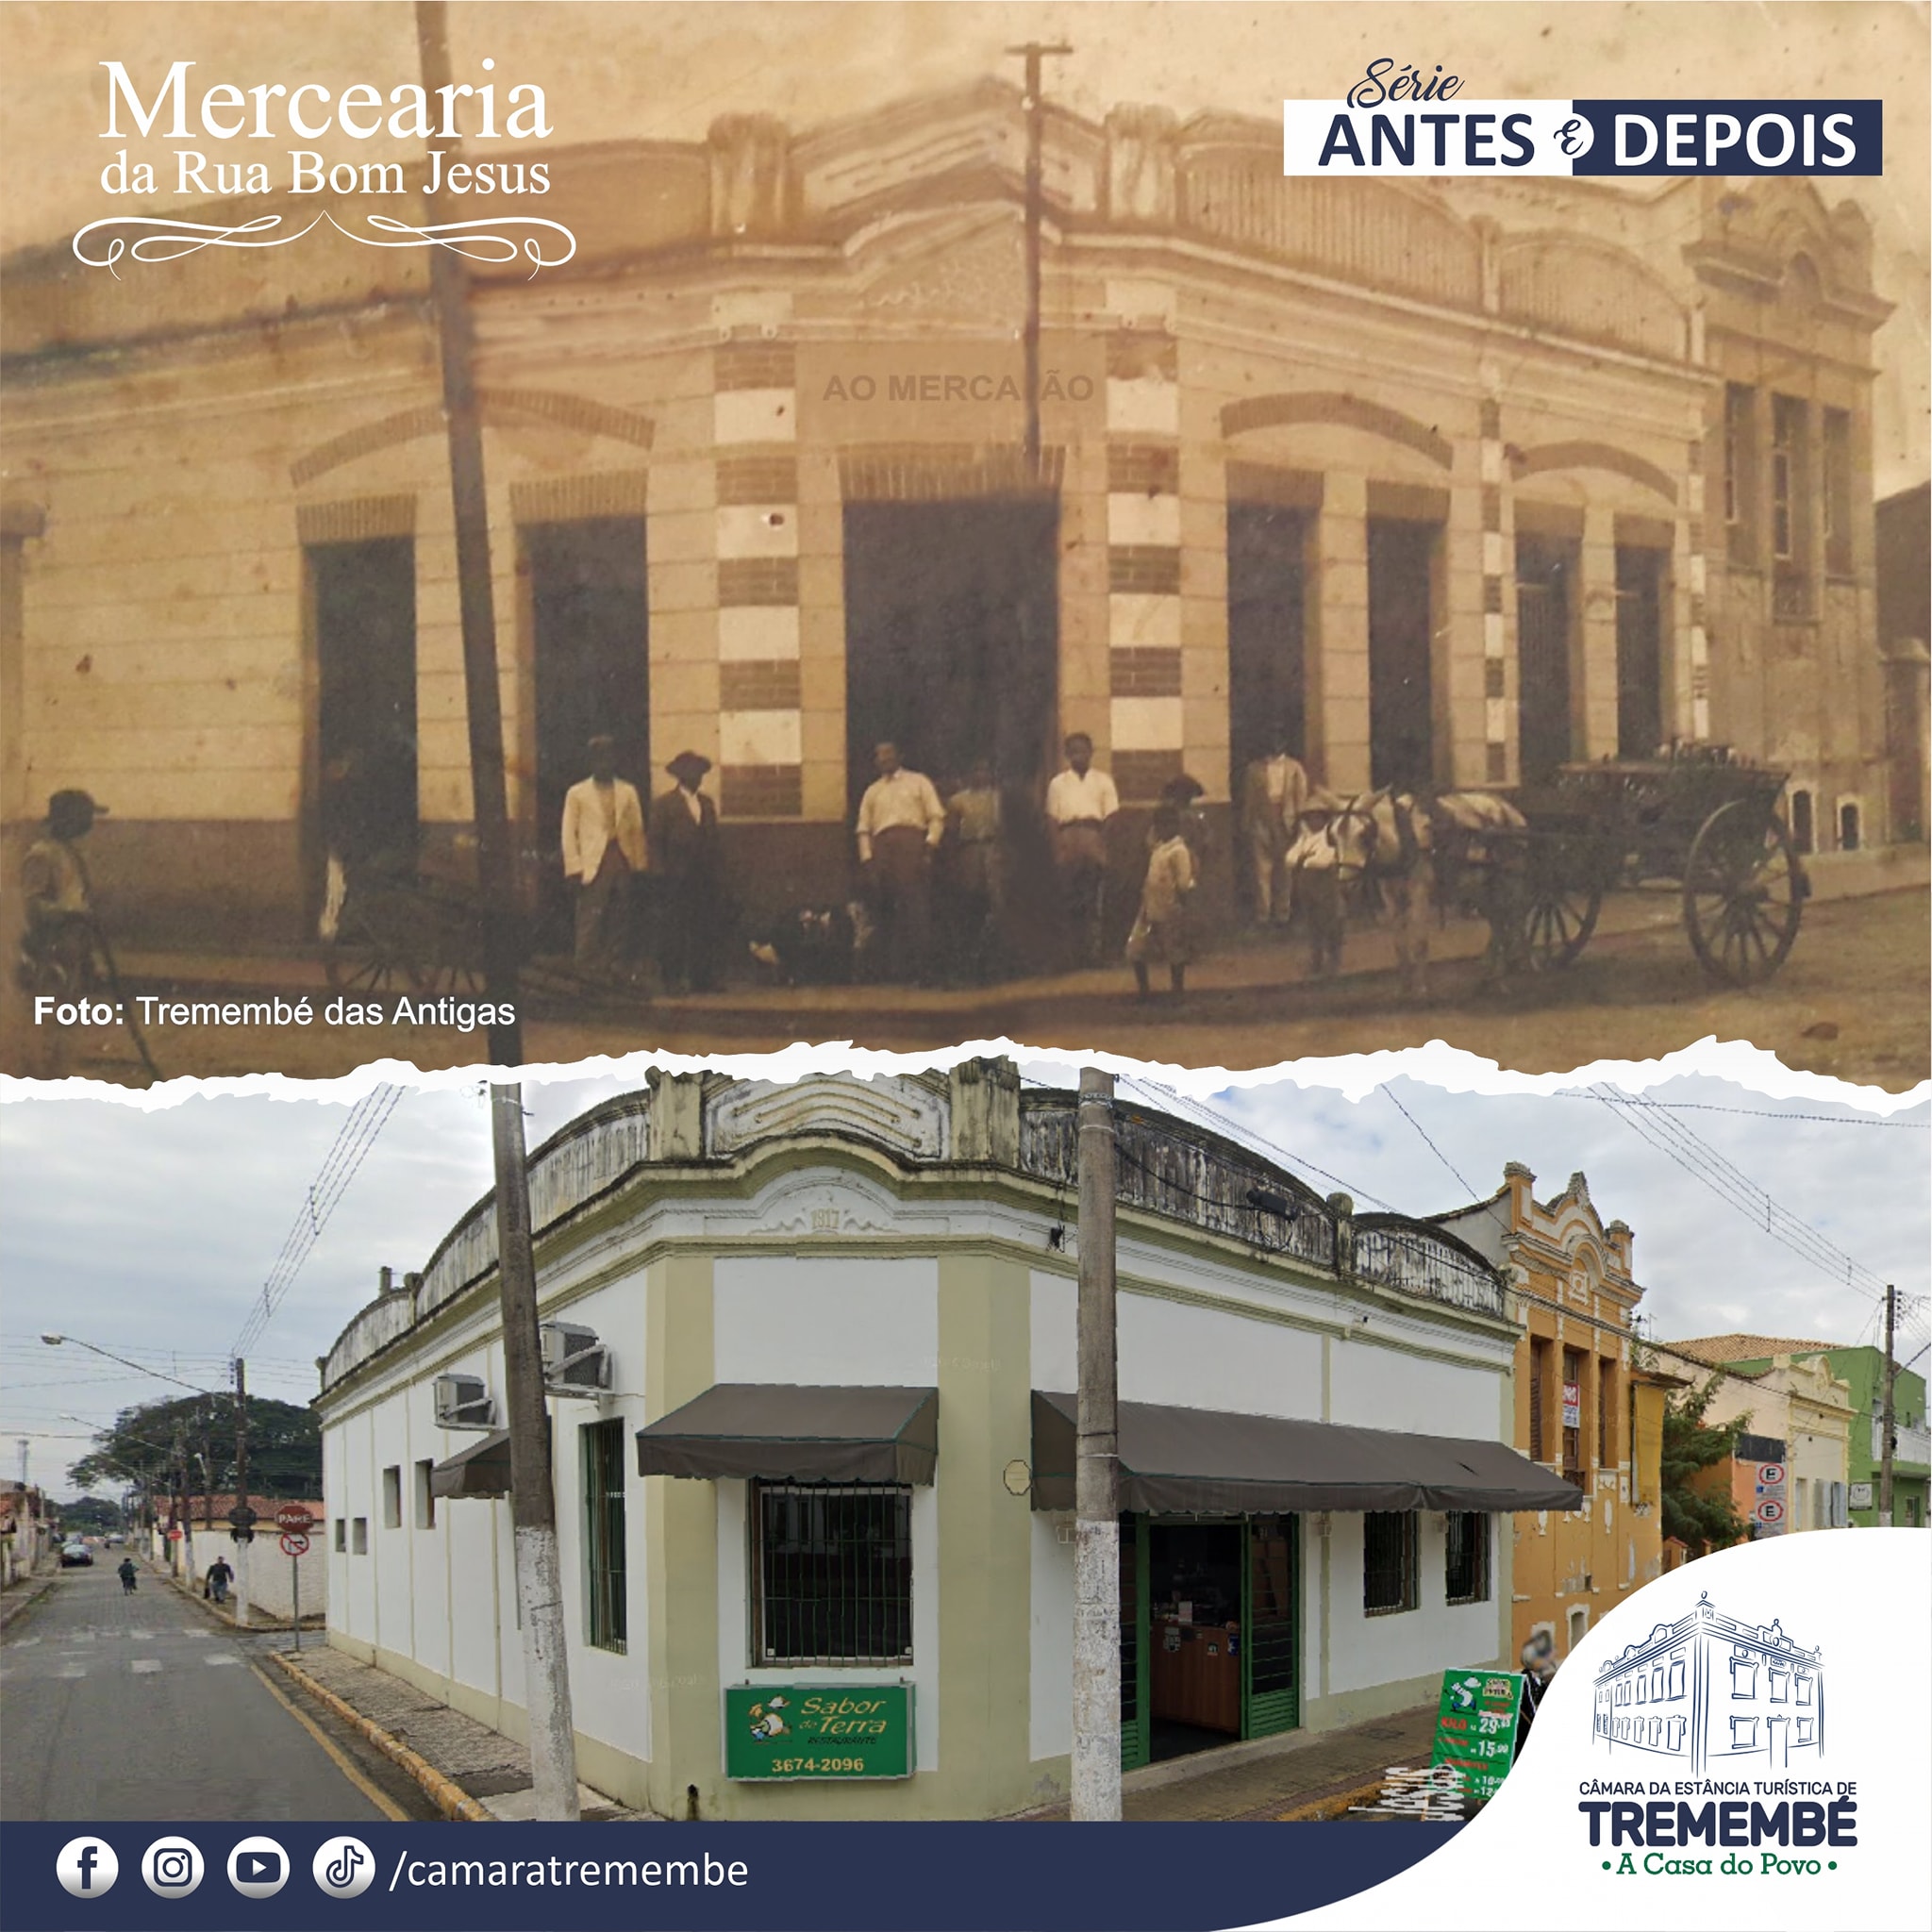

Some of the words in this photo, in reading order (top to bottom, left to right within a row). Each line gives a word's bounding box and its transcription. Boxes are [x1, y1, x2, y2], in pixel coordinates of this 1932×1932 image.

[823, 375, 876, 402] AO
[889, 369, 1094, 402] MERCAÃO
[277, 1513, 311, 1524] PARE
[800, 1696, 887, 1715] Sabor
[820, 1715, 888, 1735] Terra
[808, 1736, 877, 1745] RESTAURANTE
[772, 1757, 865, 1773] 3674-2096
